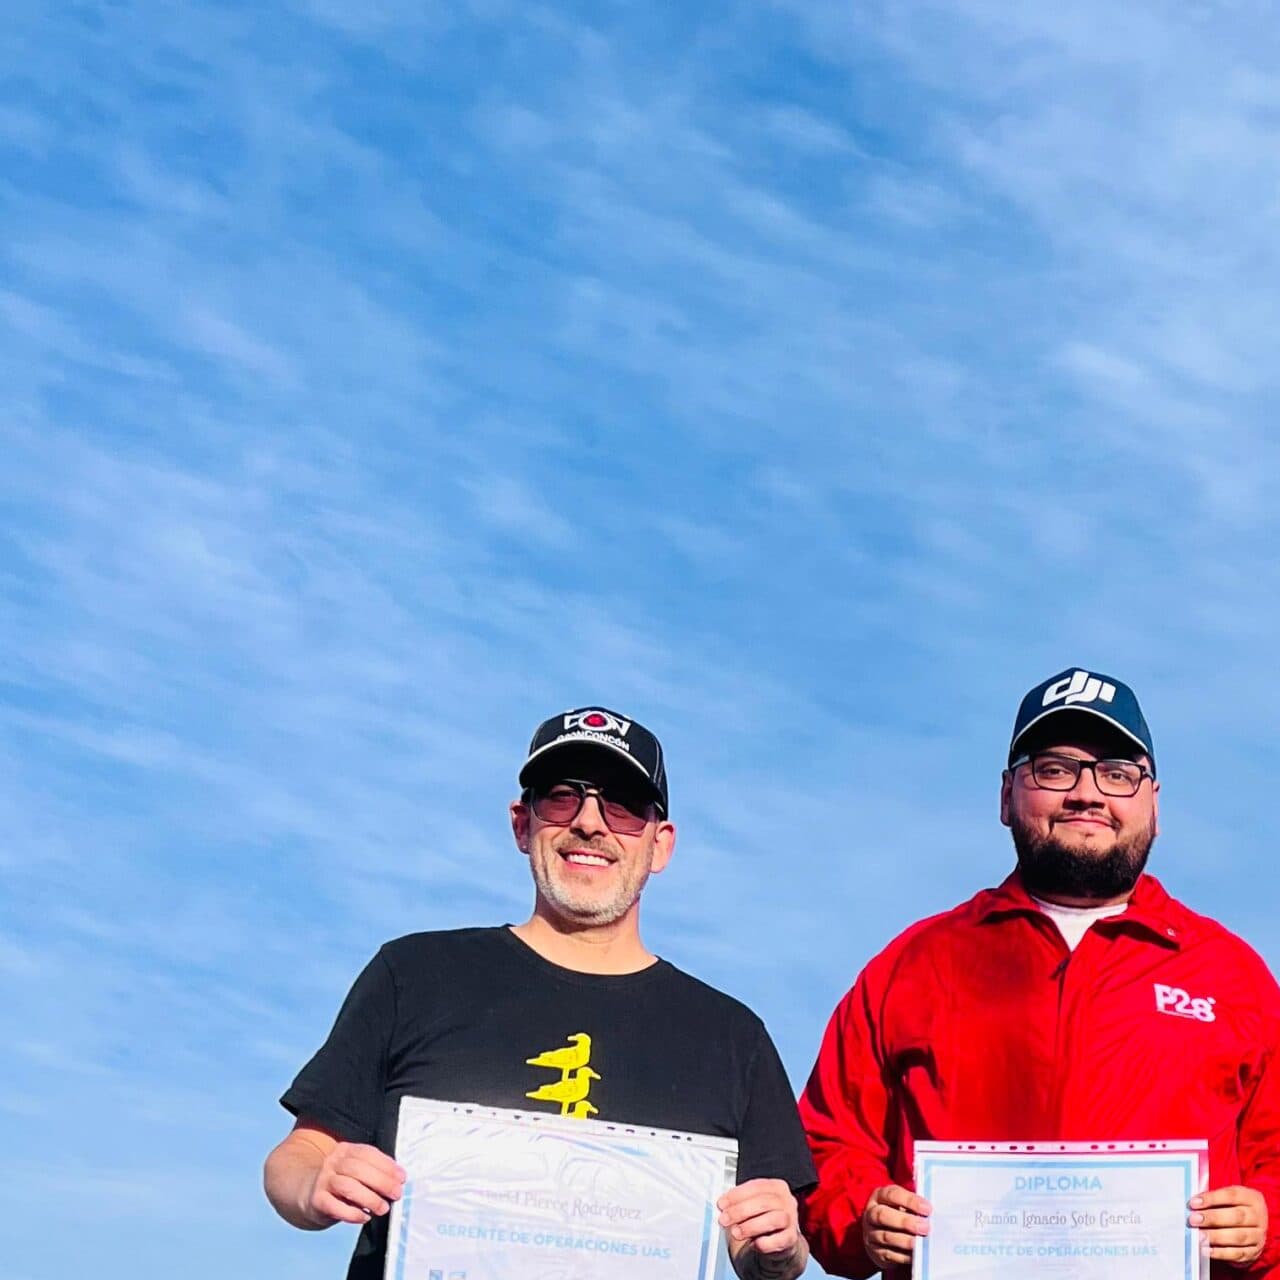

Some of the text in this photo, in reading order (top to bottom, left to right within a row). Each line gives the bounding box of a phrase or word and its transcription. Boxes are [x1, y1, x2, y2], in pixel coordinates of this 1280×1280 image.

[1014, 1176, 1103, 1191] DIPLOMA
[974, 1210, 1142, 1229] Ramón Ignacio Soto García
[437, 1224, 672, 1259] GERENTE DE OPERACIONES UAS
[953, 1244, 1159, 1257] GERENTE DE OPERACIONES UAS
